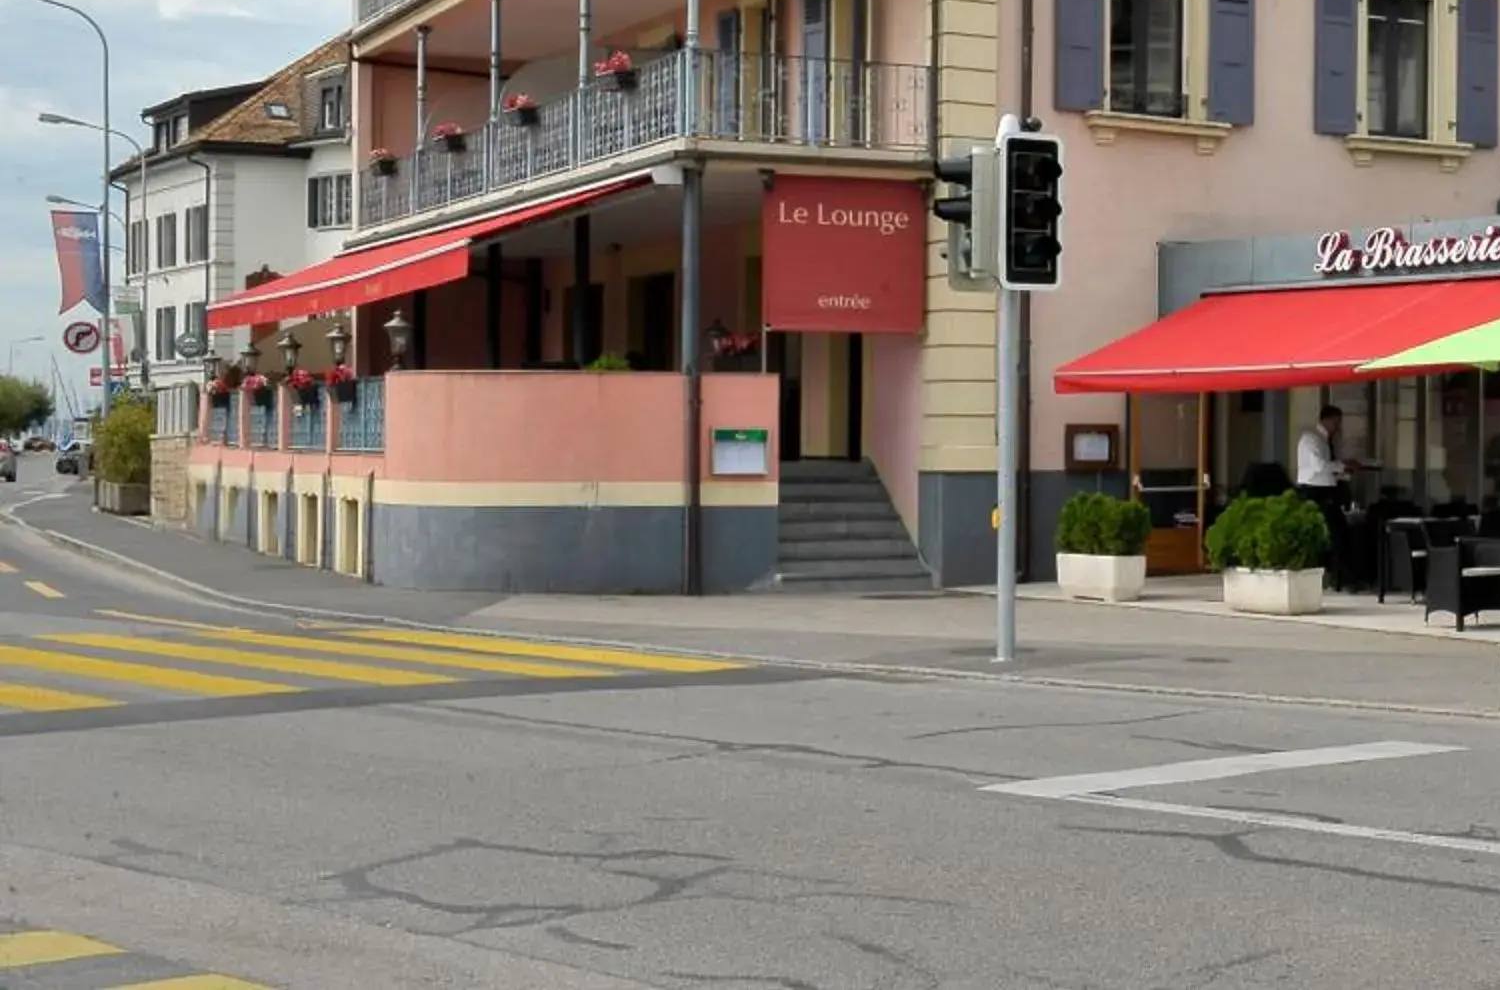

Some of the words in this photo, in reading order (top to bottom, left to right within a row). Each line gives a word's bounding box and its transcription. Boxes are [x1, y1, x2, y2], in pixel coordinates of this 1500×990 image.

[779, 202, 809, 225] Le
[817, 203, 909, 235] Lounge
[1314, 229, 1355, 273] La
[818, 293, 870, 309] entrée
